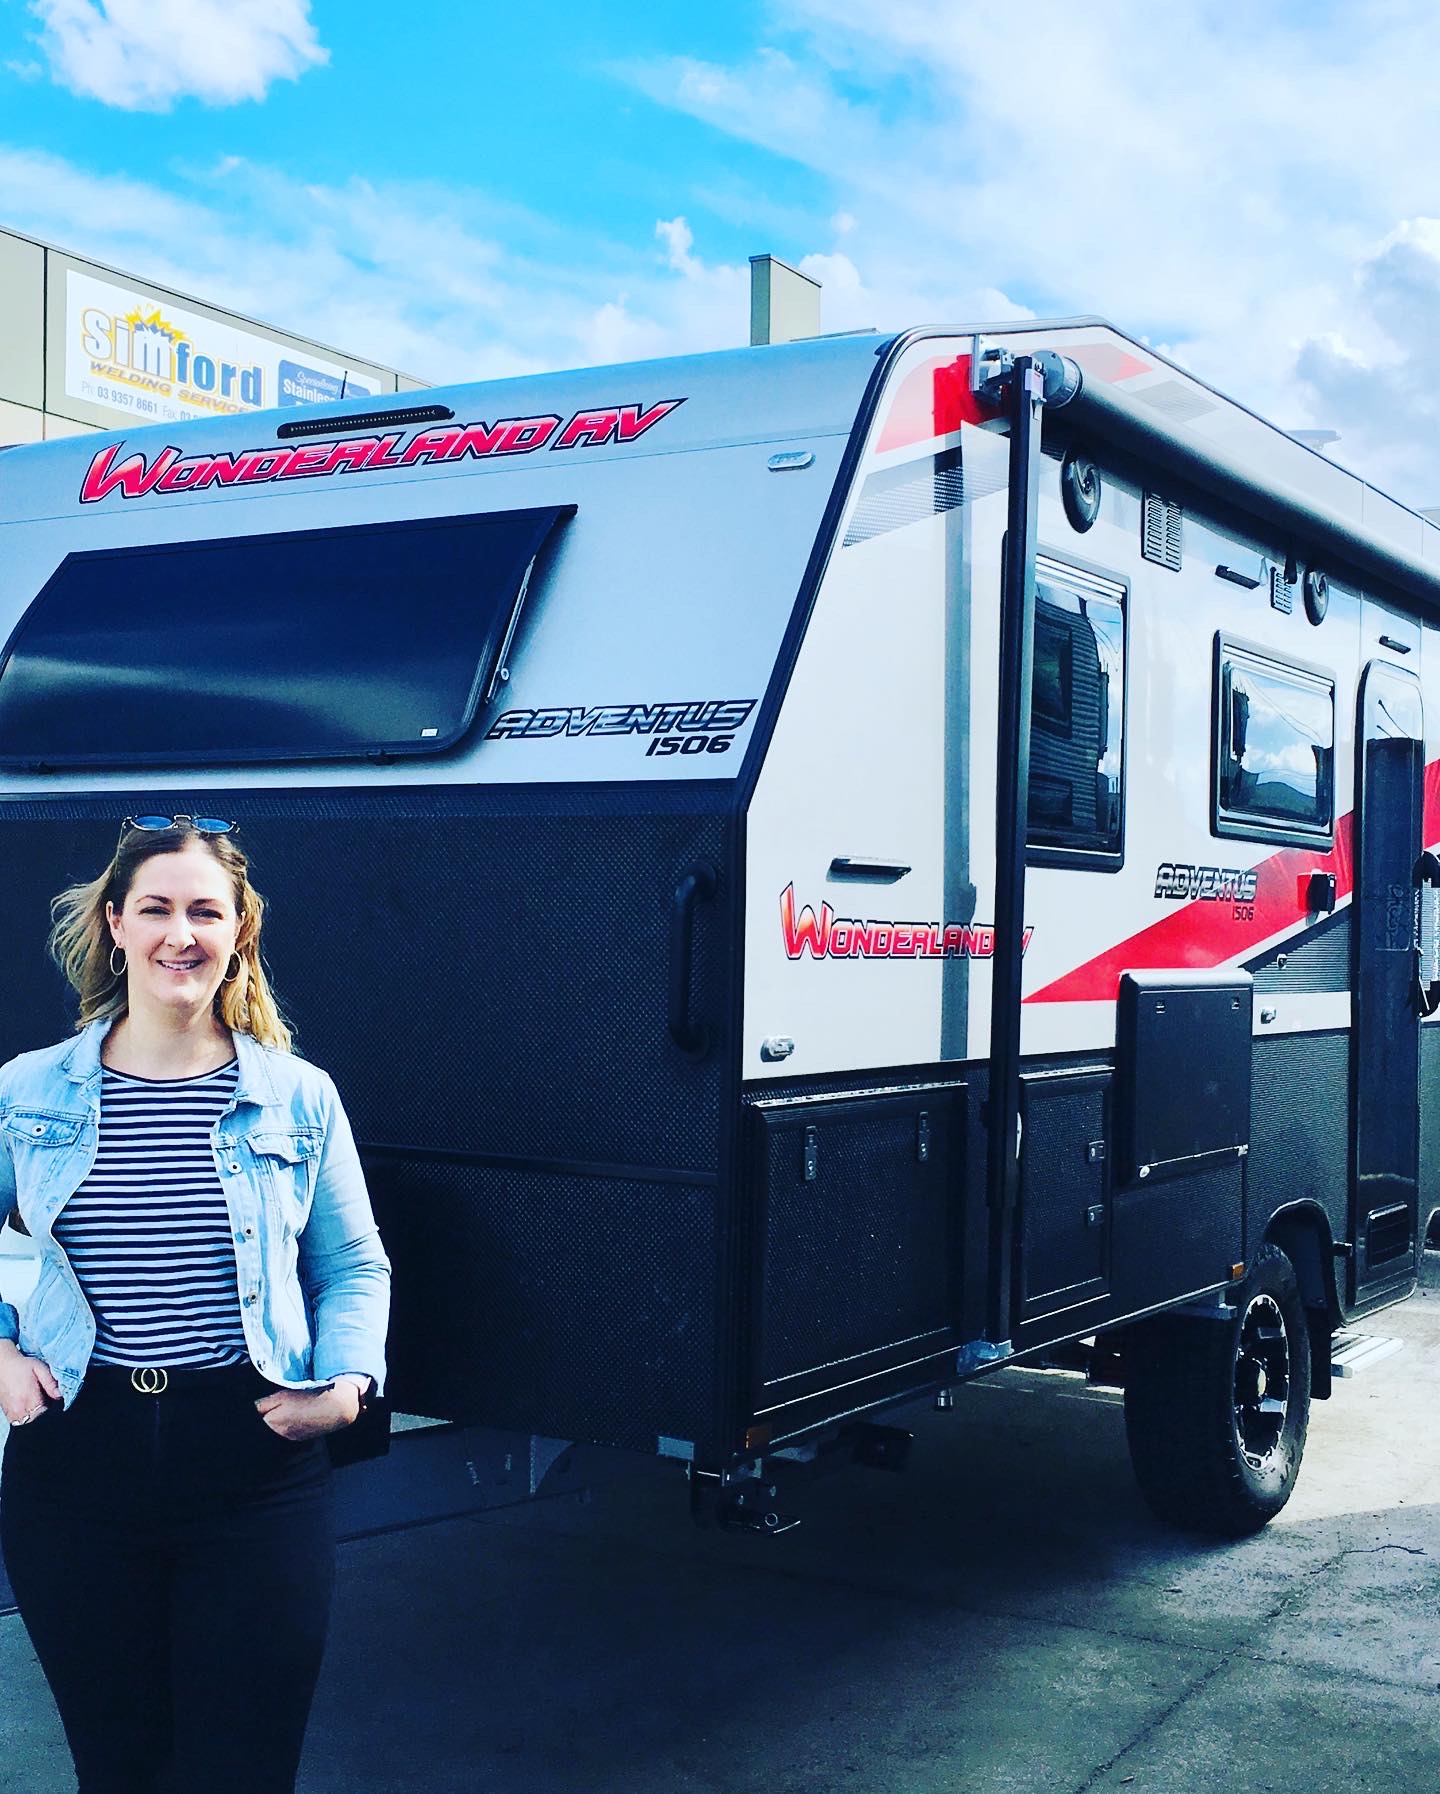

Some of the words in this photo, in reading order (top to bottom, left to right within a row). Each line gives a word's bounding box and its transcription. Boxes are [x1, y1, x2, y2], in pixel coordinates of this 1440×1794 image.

[90, 361, 172, 393] WELDING
[97, 386, 109, 400] 03
[111, 390, 134, 406] 9357
[136, 398, 158, 414] 8661
[79, 416, 557, 503] WONDERLAND
[555, 398, 688, 448] RV
[484, 699, 758, 740] ADVENTUS
[645, 734, 735, 756] 1506
[1154, 863, 1259, 903] ADVENTUS
[780, 880, 996, 960] WONDERLAND
[1232, 905, 1254, 921] 1506
